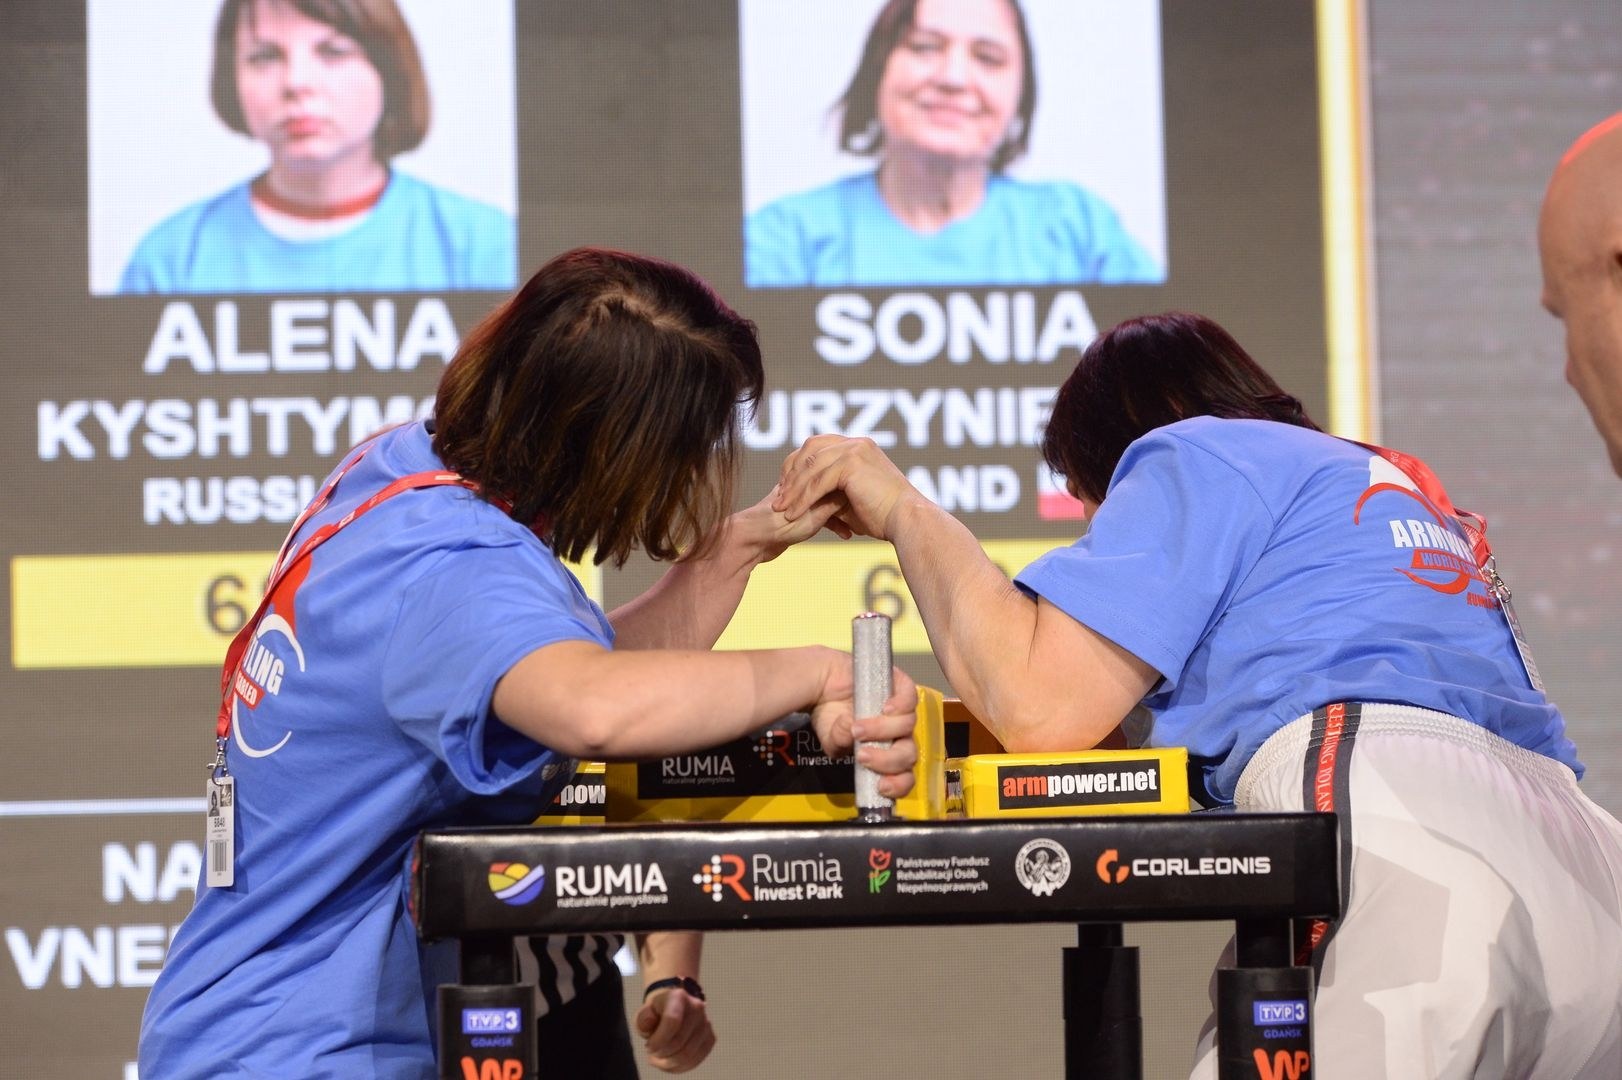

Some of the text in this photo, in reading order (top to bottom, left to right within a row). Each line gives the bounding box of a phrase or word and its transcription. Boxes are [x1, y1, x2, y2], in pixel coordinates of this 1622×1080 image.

[143, 298, 461, 374] ALENA
[814, 290, 1099, 366] SONIA
[204, 574, 267, 636] 6
[661, 754, 736, 778] RUMIA
[1002, 768, 1157, 797] armpower.net
[554, 784, 606, 806] pow
[1317, 767, 1333, 812] POLAN
[556, 862, 668, 897] RUMIA
[752, 852, 844, 884] Rumia
[1131, 856, 1271, 878] CORLEONIS
[754, 883, 844, 902] Invest Park
[4, 924, 184, 990] VNE
